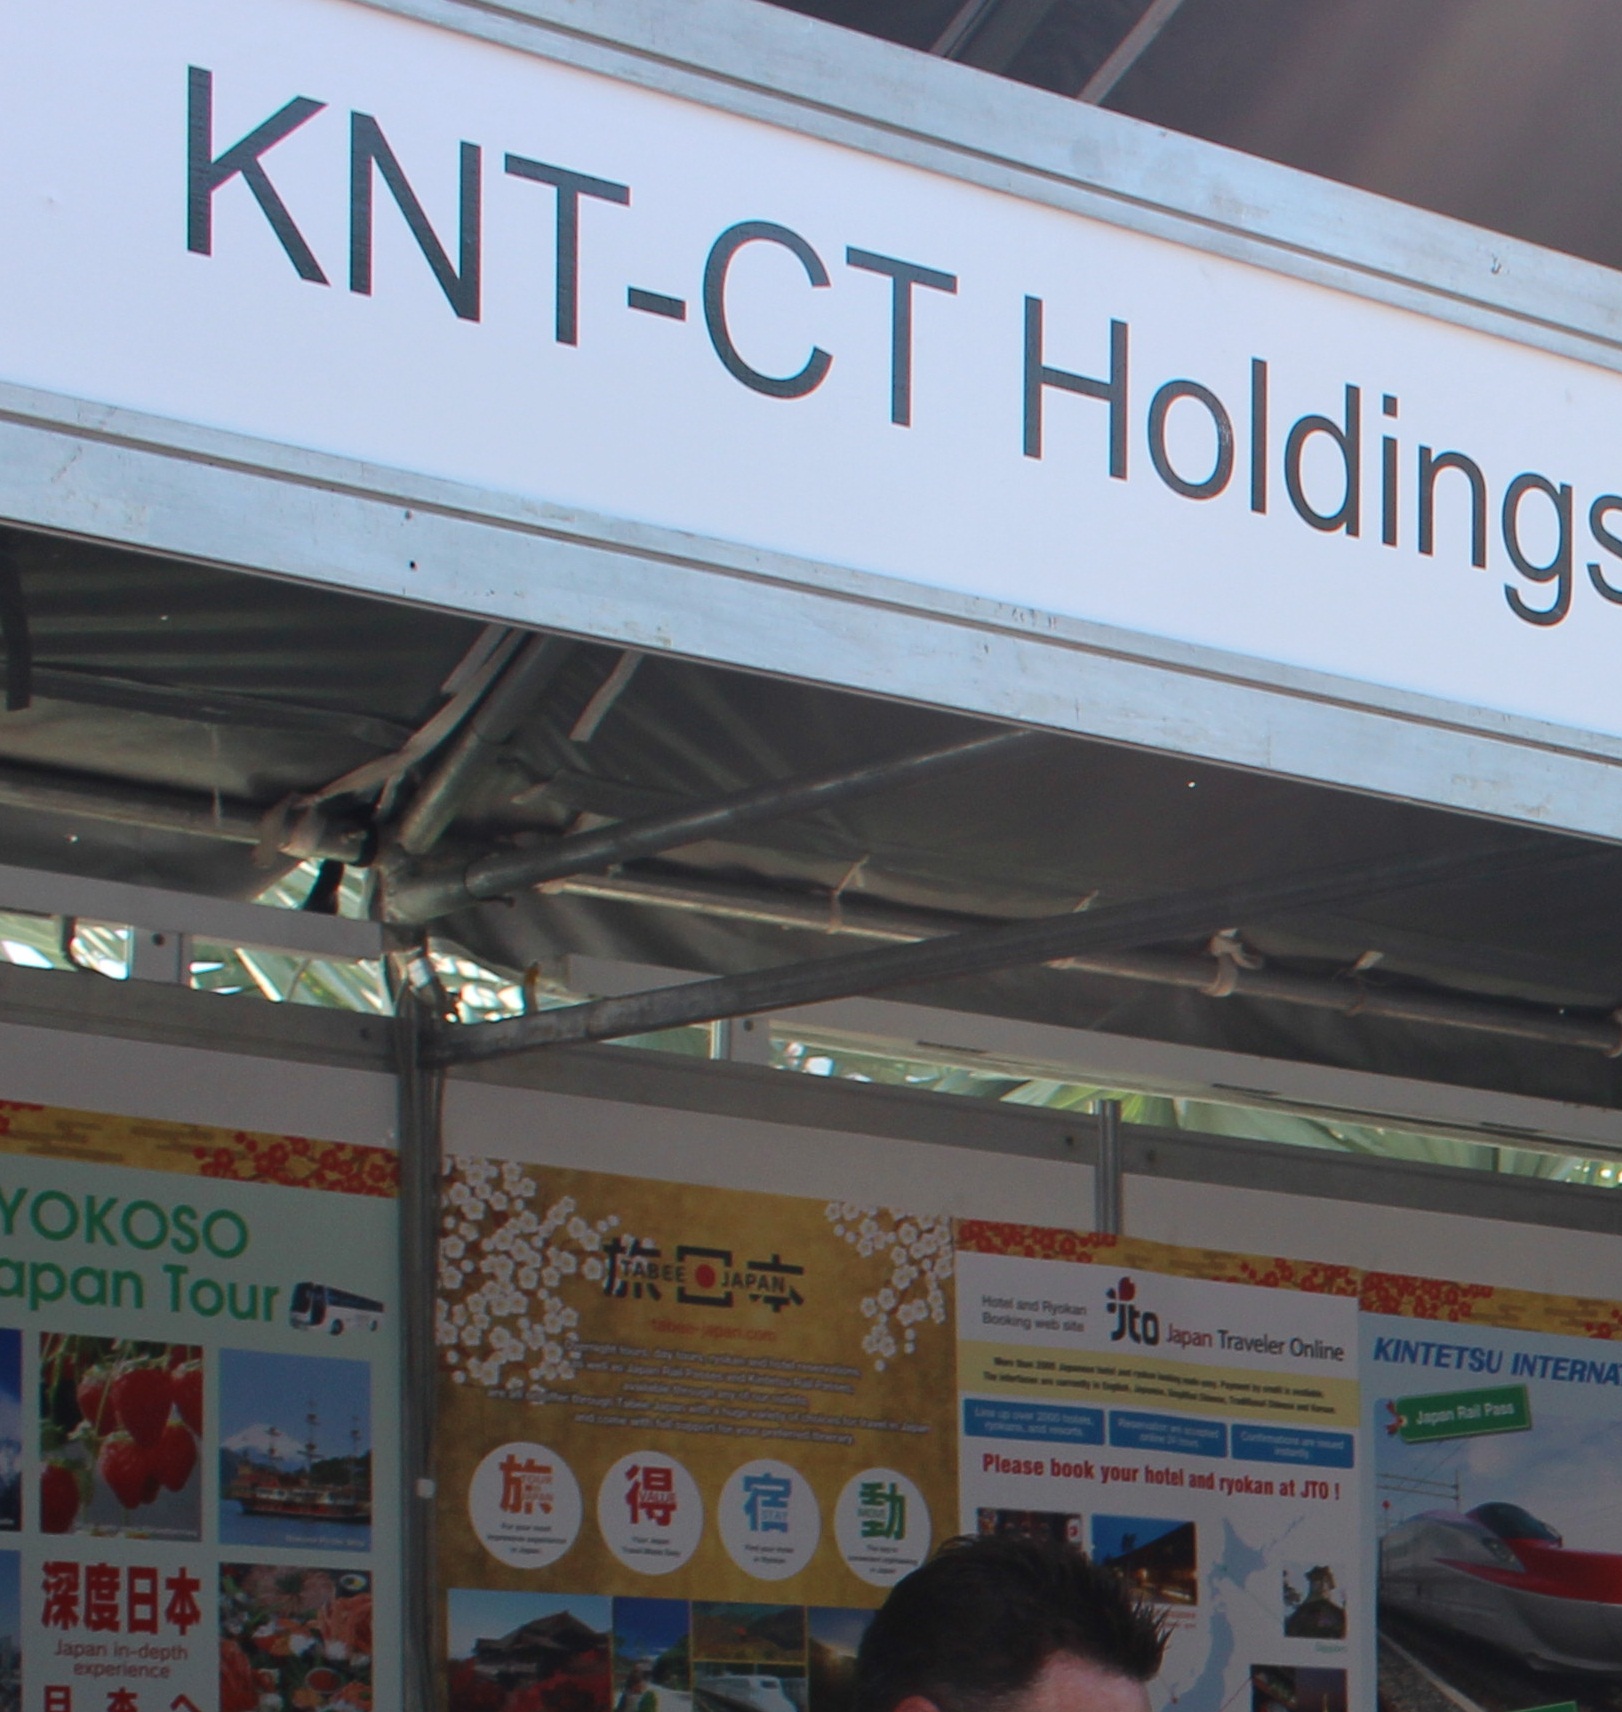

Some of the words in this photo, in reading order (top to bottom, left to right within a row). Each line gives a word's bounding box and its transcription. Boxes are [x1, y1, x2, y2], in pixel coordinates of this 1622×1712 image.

[187, 63, 957, 429] KNT-CT
[0, 1188, 248, 1259] YOKOSO
[0, 1257, 144, 1311] apan
[163, 1264, 279, 1322] Tour
[621, 1258, 686, 1283] TABEE
[721, 1273, 784, 1294] JAPAN
[982, 1296, 1013, 1311] Hotel
[1016, 1299, 1039, 1313] and
[1043, 1301, 1087, 1319] Ryokan
[982, 1312, 1032, 1331] Booking
[1035, 1316, 1060, 1331] web
[1062, 1319, 1085, 1332] site
[1166, 1324, 1212, 1349] Japan
[1217, 1329, 1285, 1355] Traveler
[1290, 1338, 1345, 1361] Online
[1373, 1336, 1503, 1375] KINTETSU
[1416, 1408, 1454, 1427] Japan
[1457, 1405, 1481, 1420] Rail
[1484, 1402, 1515, 1418] Pass
[499, 1453, 554, 1515] 旅
[625, 1463, 677, 1527] 得
[983, 1453, 1044, 1477] Please
[1051, 1458, 1094, 1480] book
[1100, 1466, 1138, 1486] your
[1145, 1469, 1184, 1487] hotel
[1189, 1472, 1214, 1490] and
[1219, 1476, 1274, 1497] ryokan
[1280, 1482, 1295, 1498] at
[1301, 1482, 1329, 1500] JTO
[1334, 1483, 1340, 1500] !
[743, 1472, 792, 1533] 宿
[858, 1482, 906, 1540] 動
[41, 1561, 201, 1635] 深度日本
[54, 1640, 108, 1659] Japan
[114, 1641, 188, 1661] in-depth
[74, 1661, 171, 1680] experience
